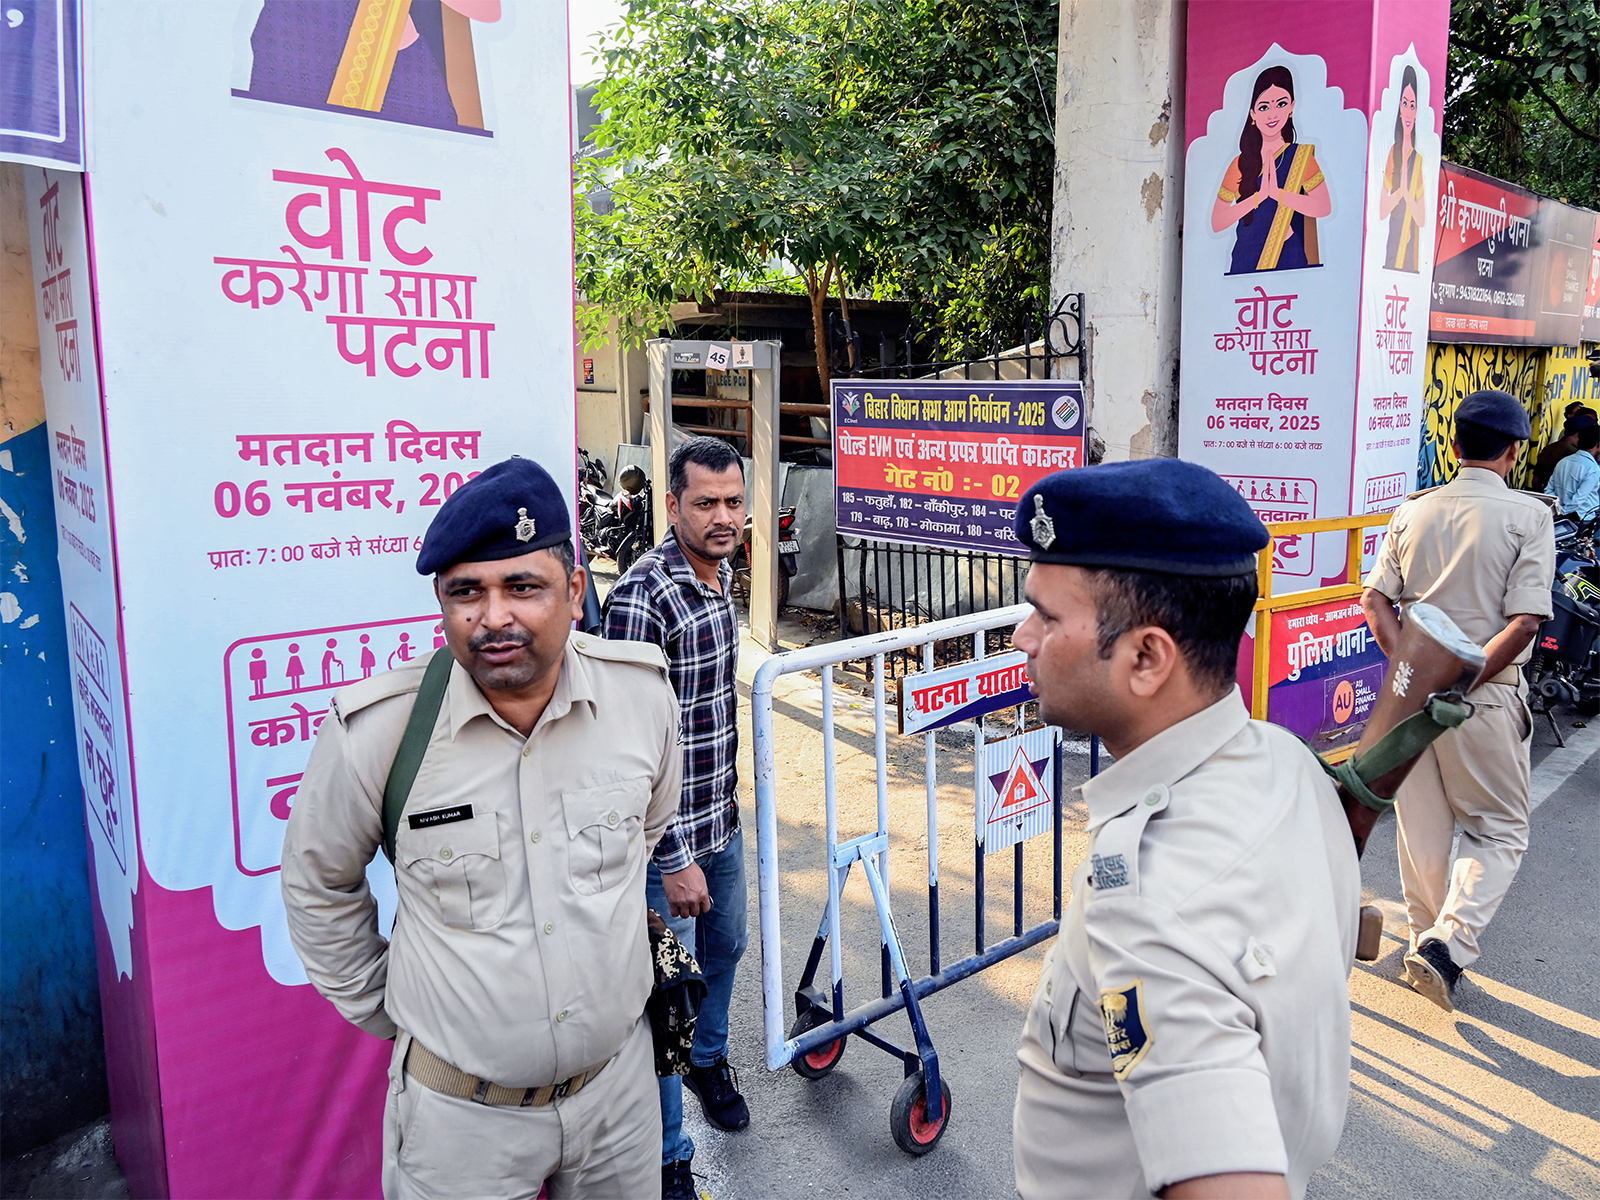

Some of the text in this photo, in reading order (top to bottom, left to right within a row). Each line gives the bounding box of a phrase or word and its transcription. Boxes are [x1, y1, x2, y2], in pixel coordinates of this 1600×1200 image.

[272, 147, 441, 266] वोट
[1439, 180, 1531, 255] श्री कृष्णापुरी थाना
[1477, 257, 1494, 278] पटना
[213, 245, 477, 320] करेगा सारा
[1235, 285, 1298, 330] वोट
[1385, 284, 1409, 329] वोट
[326, 315, 496, 379] पटना
[1213, 326, 1312, 352] करेगा सारा
[710, 352, 726, 364] 45
[1249, 349, 1319, 376] पटना
[1389, 350, 1414, 375] पटना
[1551, 373, 1567, 399] OF
[1569, 366, 1590, 399] MY
[863, 392, 889, 420] बिहार
[890, 393, 920, 421] विधान
[922, 400, 942, 422] सभा
[944, 400, 967, 422] आम
[969, 393, 1011, 424] निर्वाचन
[1215, 392, 1309, 411] मतदान दिवस
[1207, 413, 1321, 433] 06 नवंबर, 2025
[236, 420, 482, 468] मतदान दिवस
[838, 430, 1077, 468] पोल्ड EVM एवं अन्य प्रपत्र प्राप्ति काउन्टर
[214, 480, 272, 519] 06
[284, 470, 406, 514] नवंबर,
[884, 463, 918, 489] गेट
[991, 473, 1020, 498] 02
[842, 492, 855, 503] 185
[899, 497, 913, 510] 182
[971, 504, 987, 517] 184
[998, 508, 1017, 520] पट
[850, 511, 863, 523] 179
[896, 516, 909, 528] 178
[966, 524, 982, 537] 180
[309, 537, 341, 559] बजे
[345, 535, 362, 557] से
[366, 535, 409, 555] संध्या
[1287, 617, 1305, 630] हमारा
[1305, 612, 1319, 626] ध्येय
[1325, 609, 1347, 622] आमजन
[1287, 631, 1334, 681] पुलिस
[911, 678, 970, 714] पटना
[1335, 691, 1352, 712] AU
[1355, 686, 1371, 697] SMALL
[1355, 692, 1377, 706] FINANCE
[1354, 703, 1369, 715] BANK
